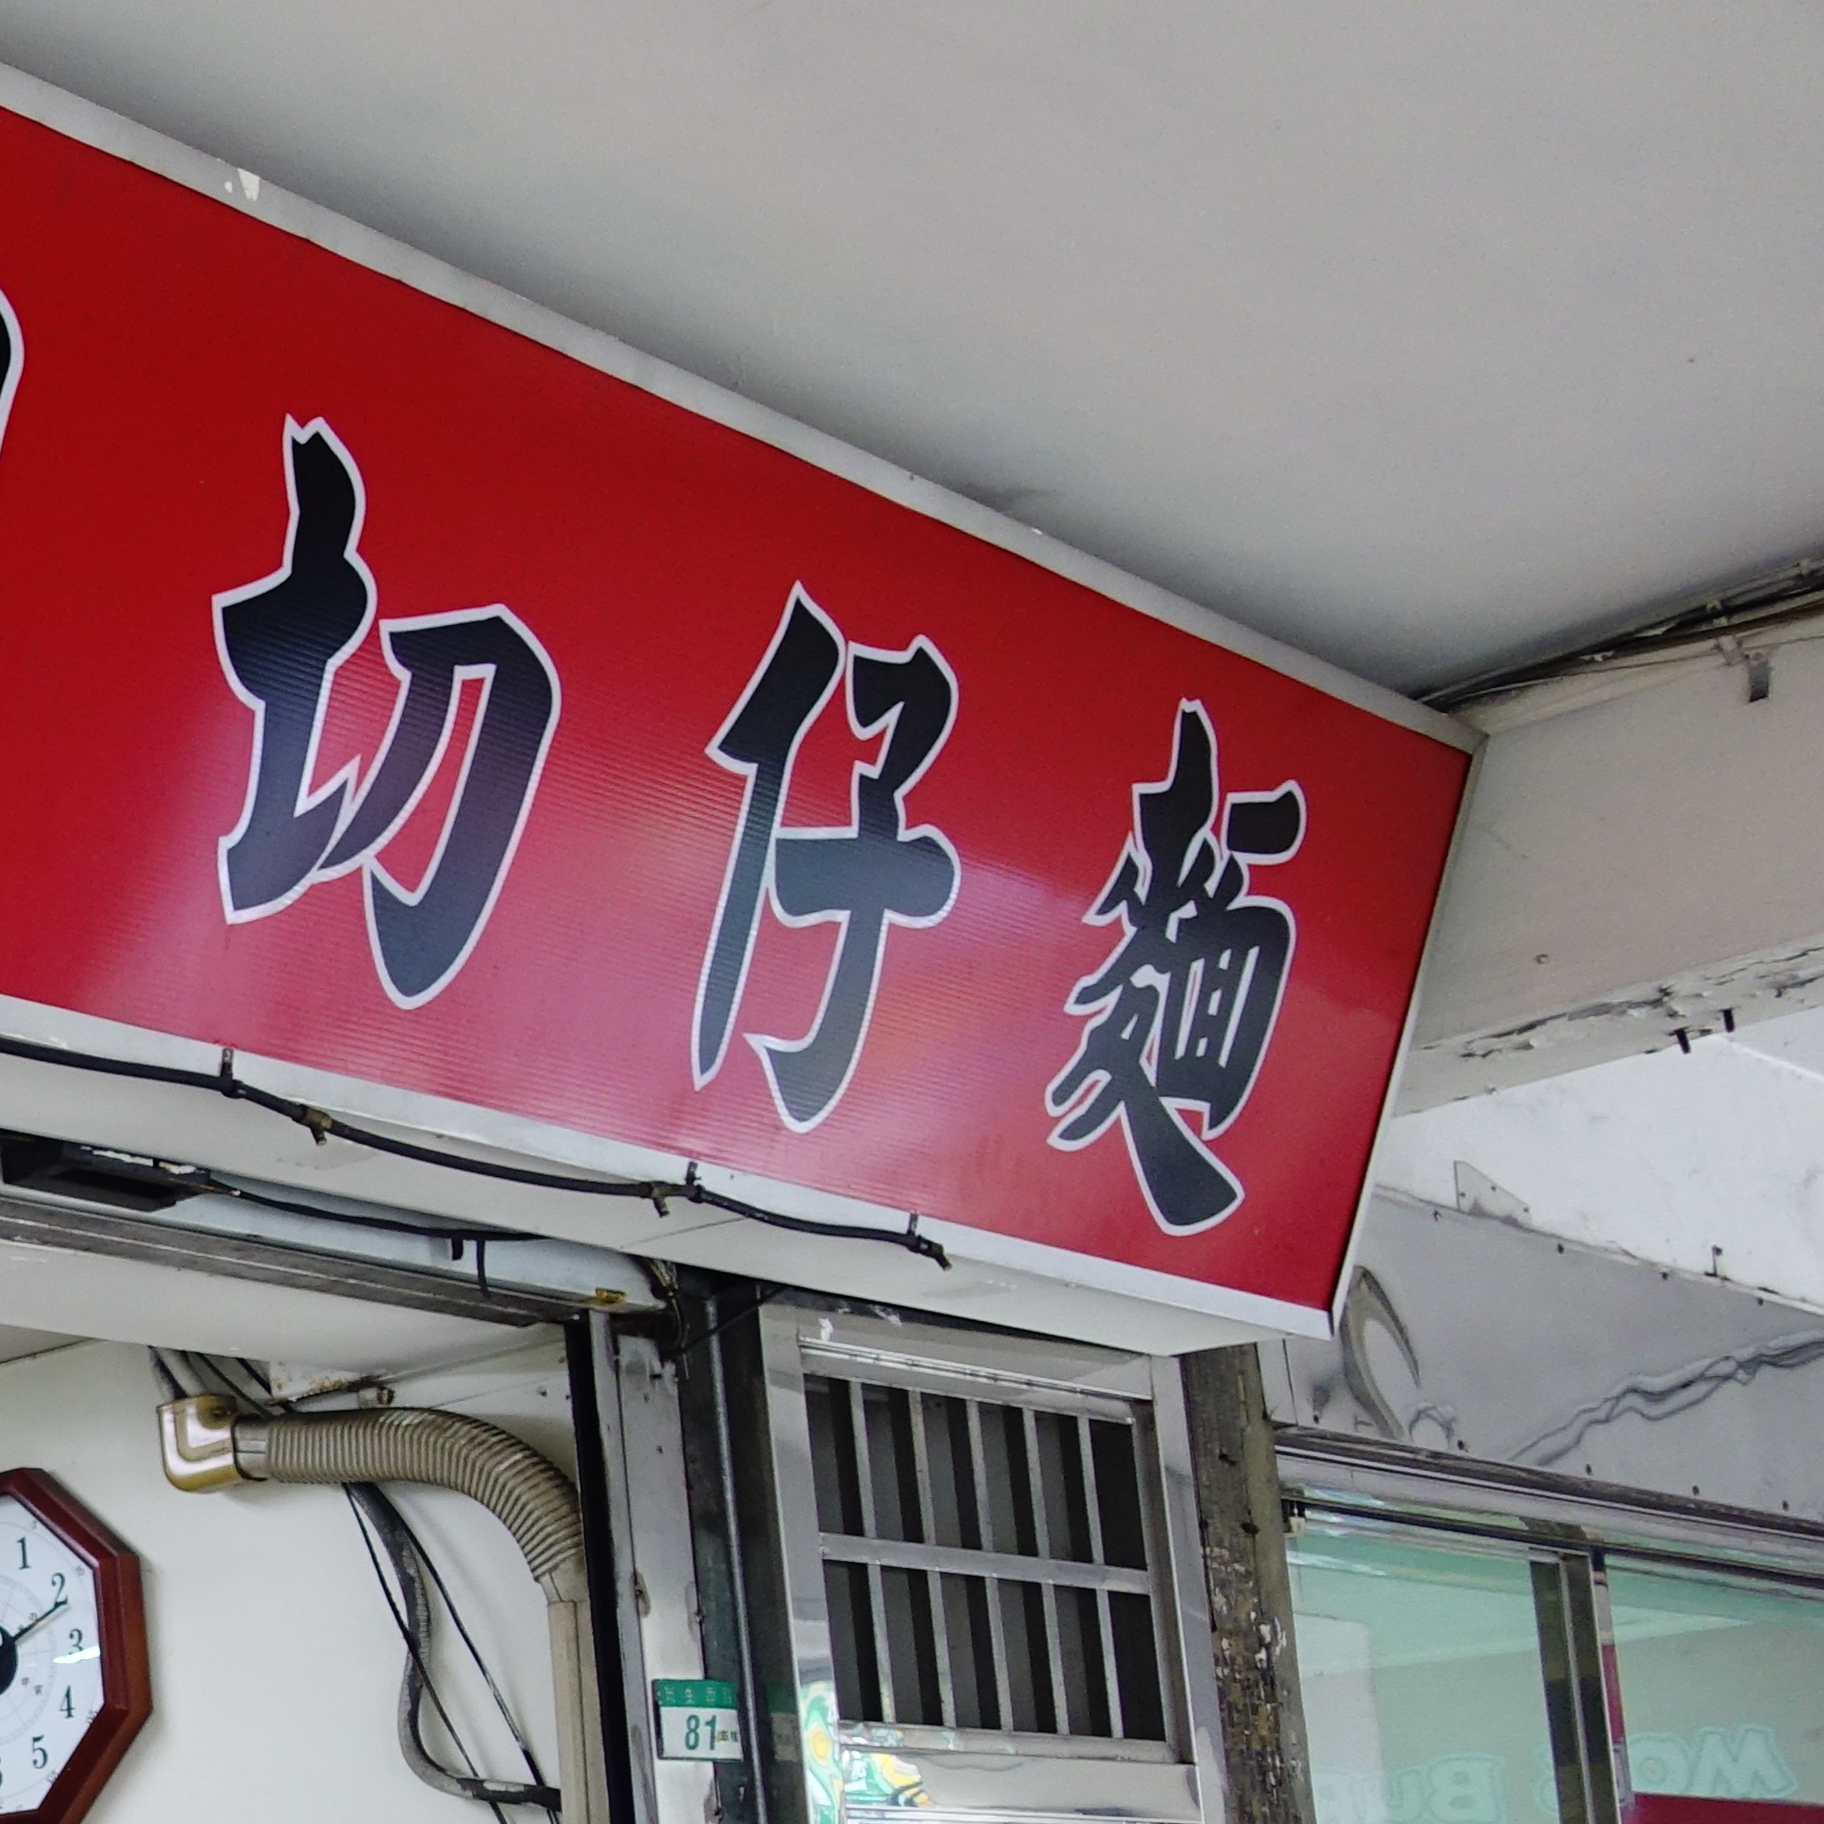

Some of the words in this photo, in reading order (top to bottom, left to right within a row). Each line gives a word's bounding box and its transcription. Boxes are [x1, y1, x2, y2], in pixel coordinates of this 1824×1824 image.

[16, 1537, 30, 1570] 1
[52, 1572, 68, 1605] 2
[60, 1685, 76, 1719] 4
[685, 1714, 717, 1751] 81
[32, 1735, 48, 1769] 5
